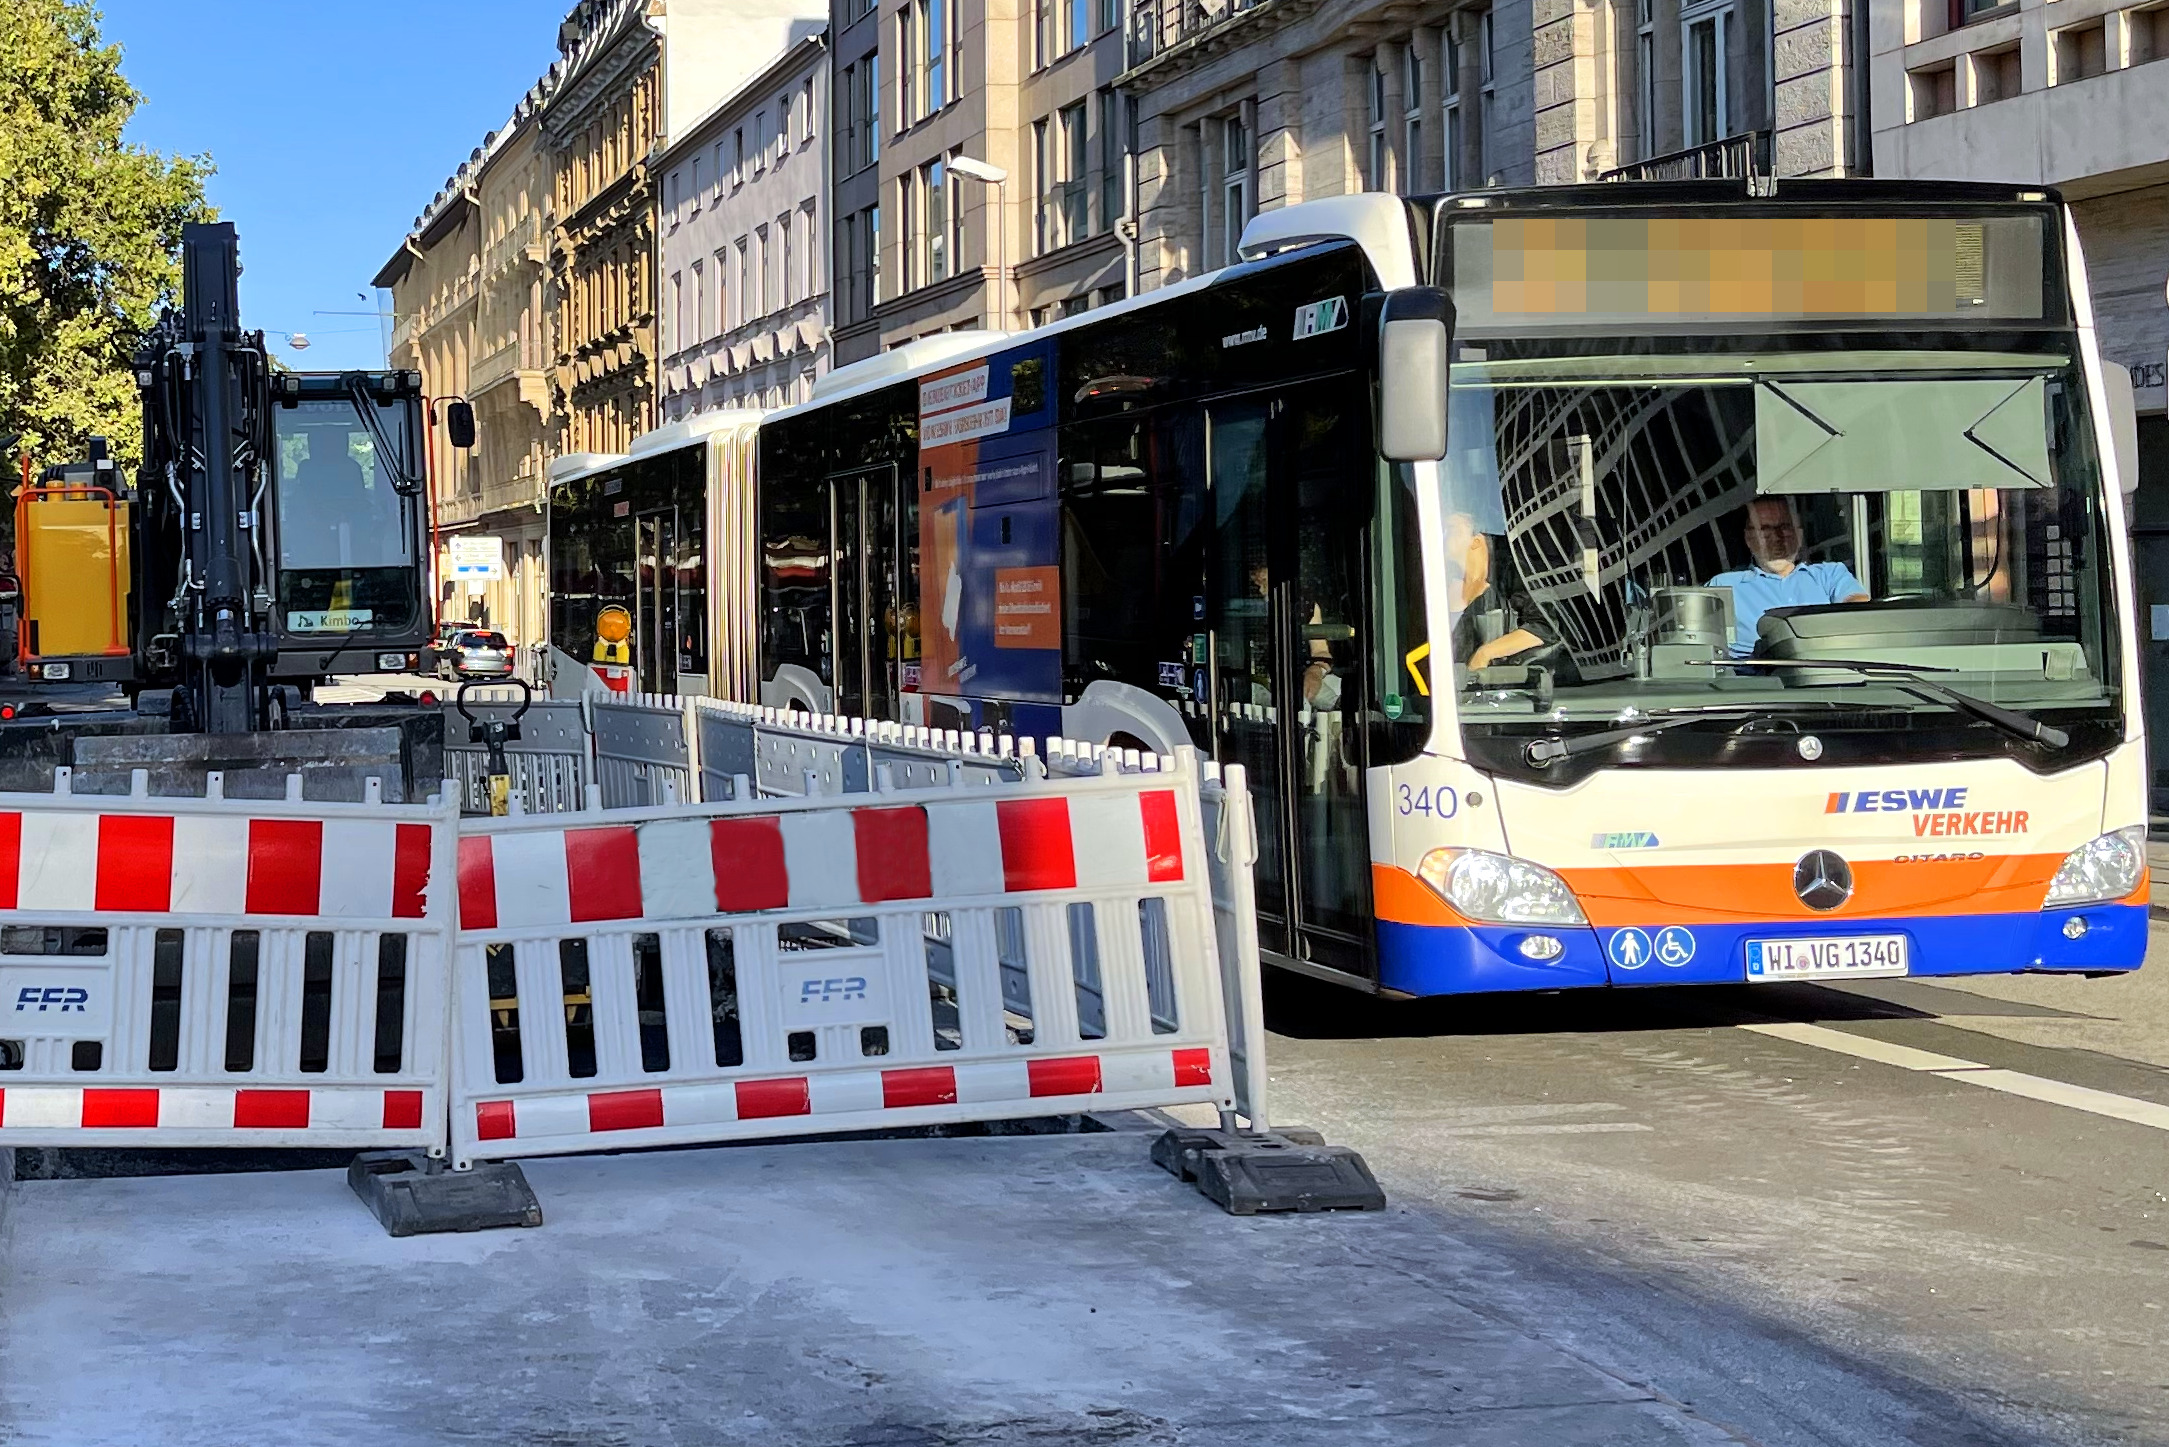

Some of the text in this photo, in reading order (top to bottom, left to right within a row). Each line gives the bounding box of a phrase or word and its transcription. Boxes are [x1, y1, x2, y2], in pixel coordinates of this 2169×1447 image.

[320, 615, 359, 626] Kimbo
[1399, 784, 1457, 819] 340
[1853, 787, 1968, 812] ESWE
[1912, 811, 2029, 837] VERKEHR
[1767, 940, 1900, 971] WI VG 1340
[16, 987, 89, 1012] FFR
[801, 976, 867, 1003] FFR
